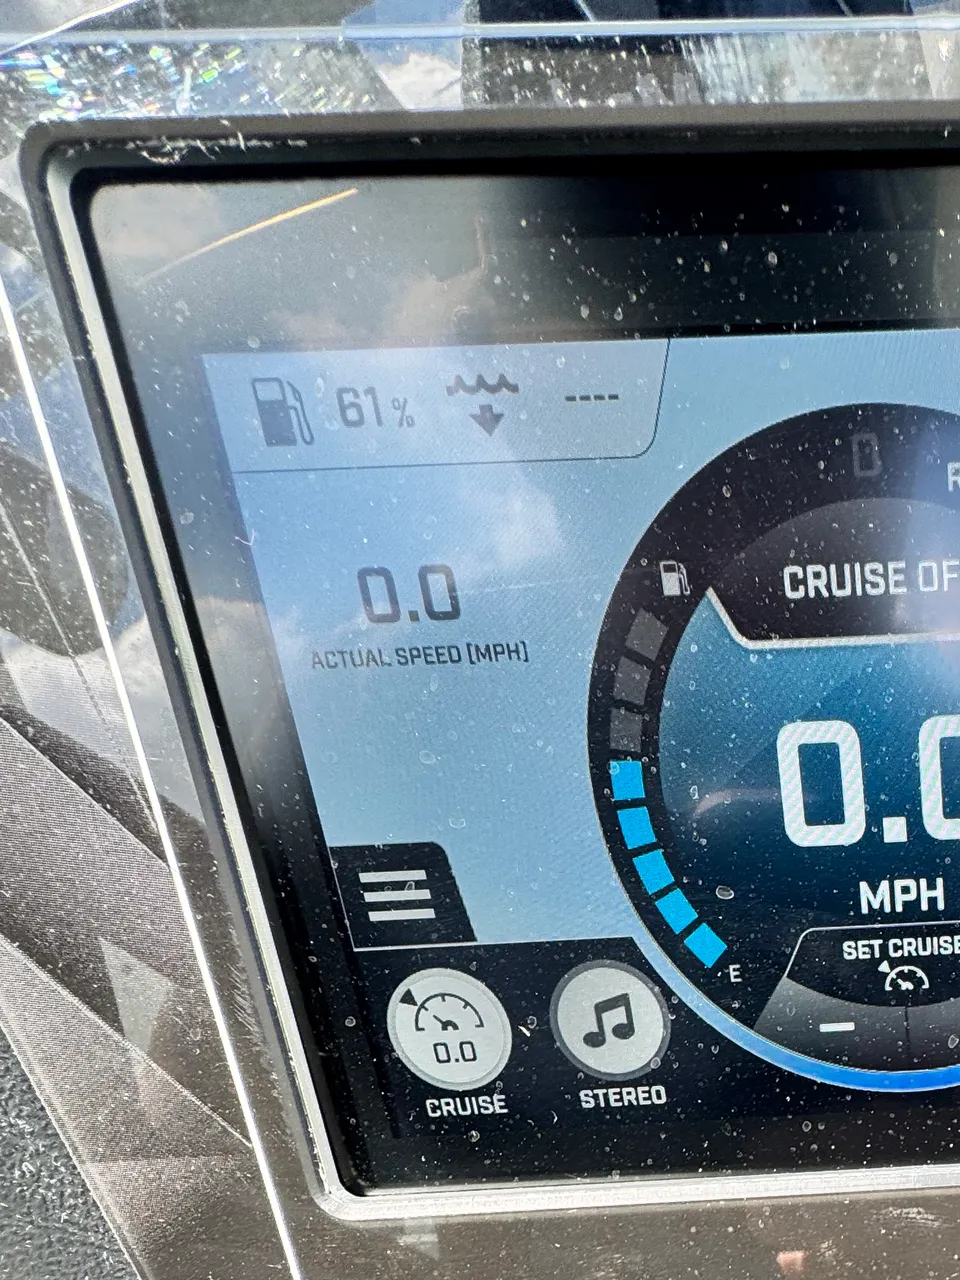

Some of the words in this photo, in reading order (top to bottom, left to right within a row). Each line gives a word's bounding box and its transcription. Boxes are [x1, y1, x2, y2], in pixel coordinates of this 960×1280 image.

[783, 561, 908, 600] CRUISE
[356, 563, 462, 625] 0.0
[310, 646, 393, 671] ACTUAL
[394, 644, 462, 668] SPEED
[466, 640, 530, 667] [MPH]
[858, 876, 946, 915] MPH
[841, 937, 884, 961] SET
[728, 964, 743, 983] E
[432, 1039, 478, 1064] 0.0
[425, 1093, 509, 1118] CRUISE
[579, 1085, 668, 1109] STEREO
